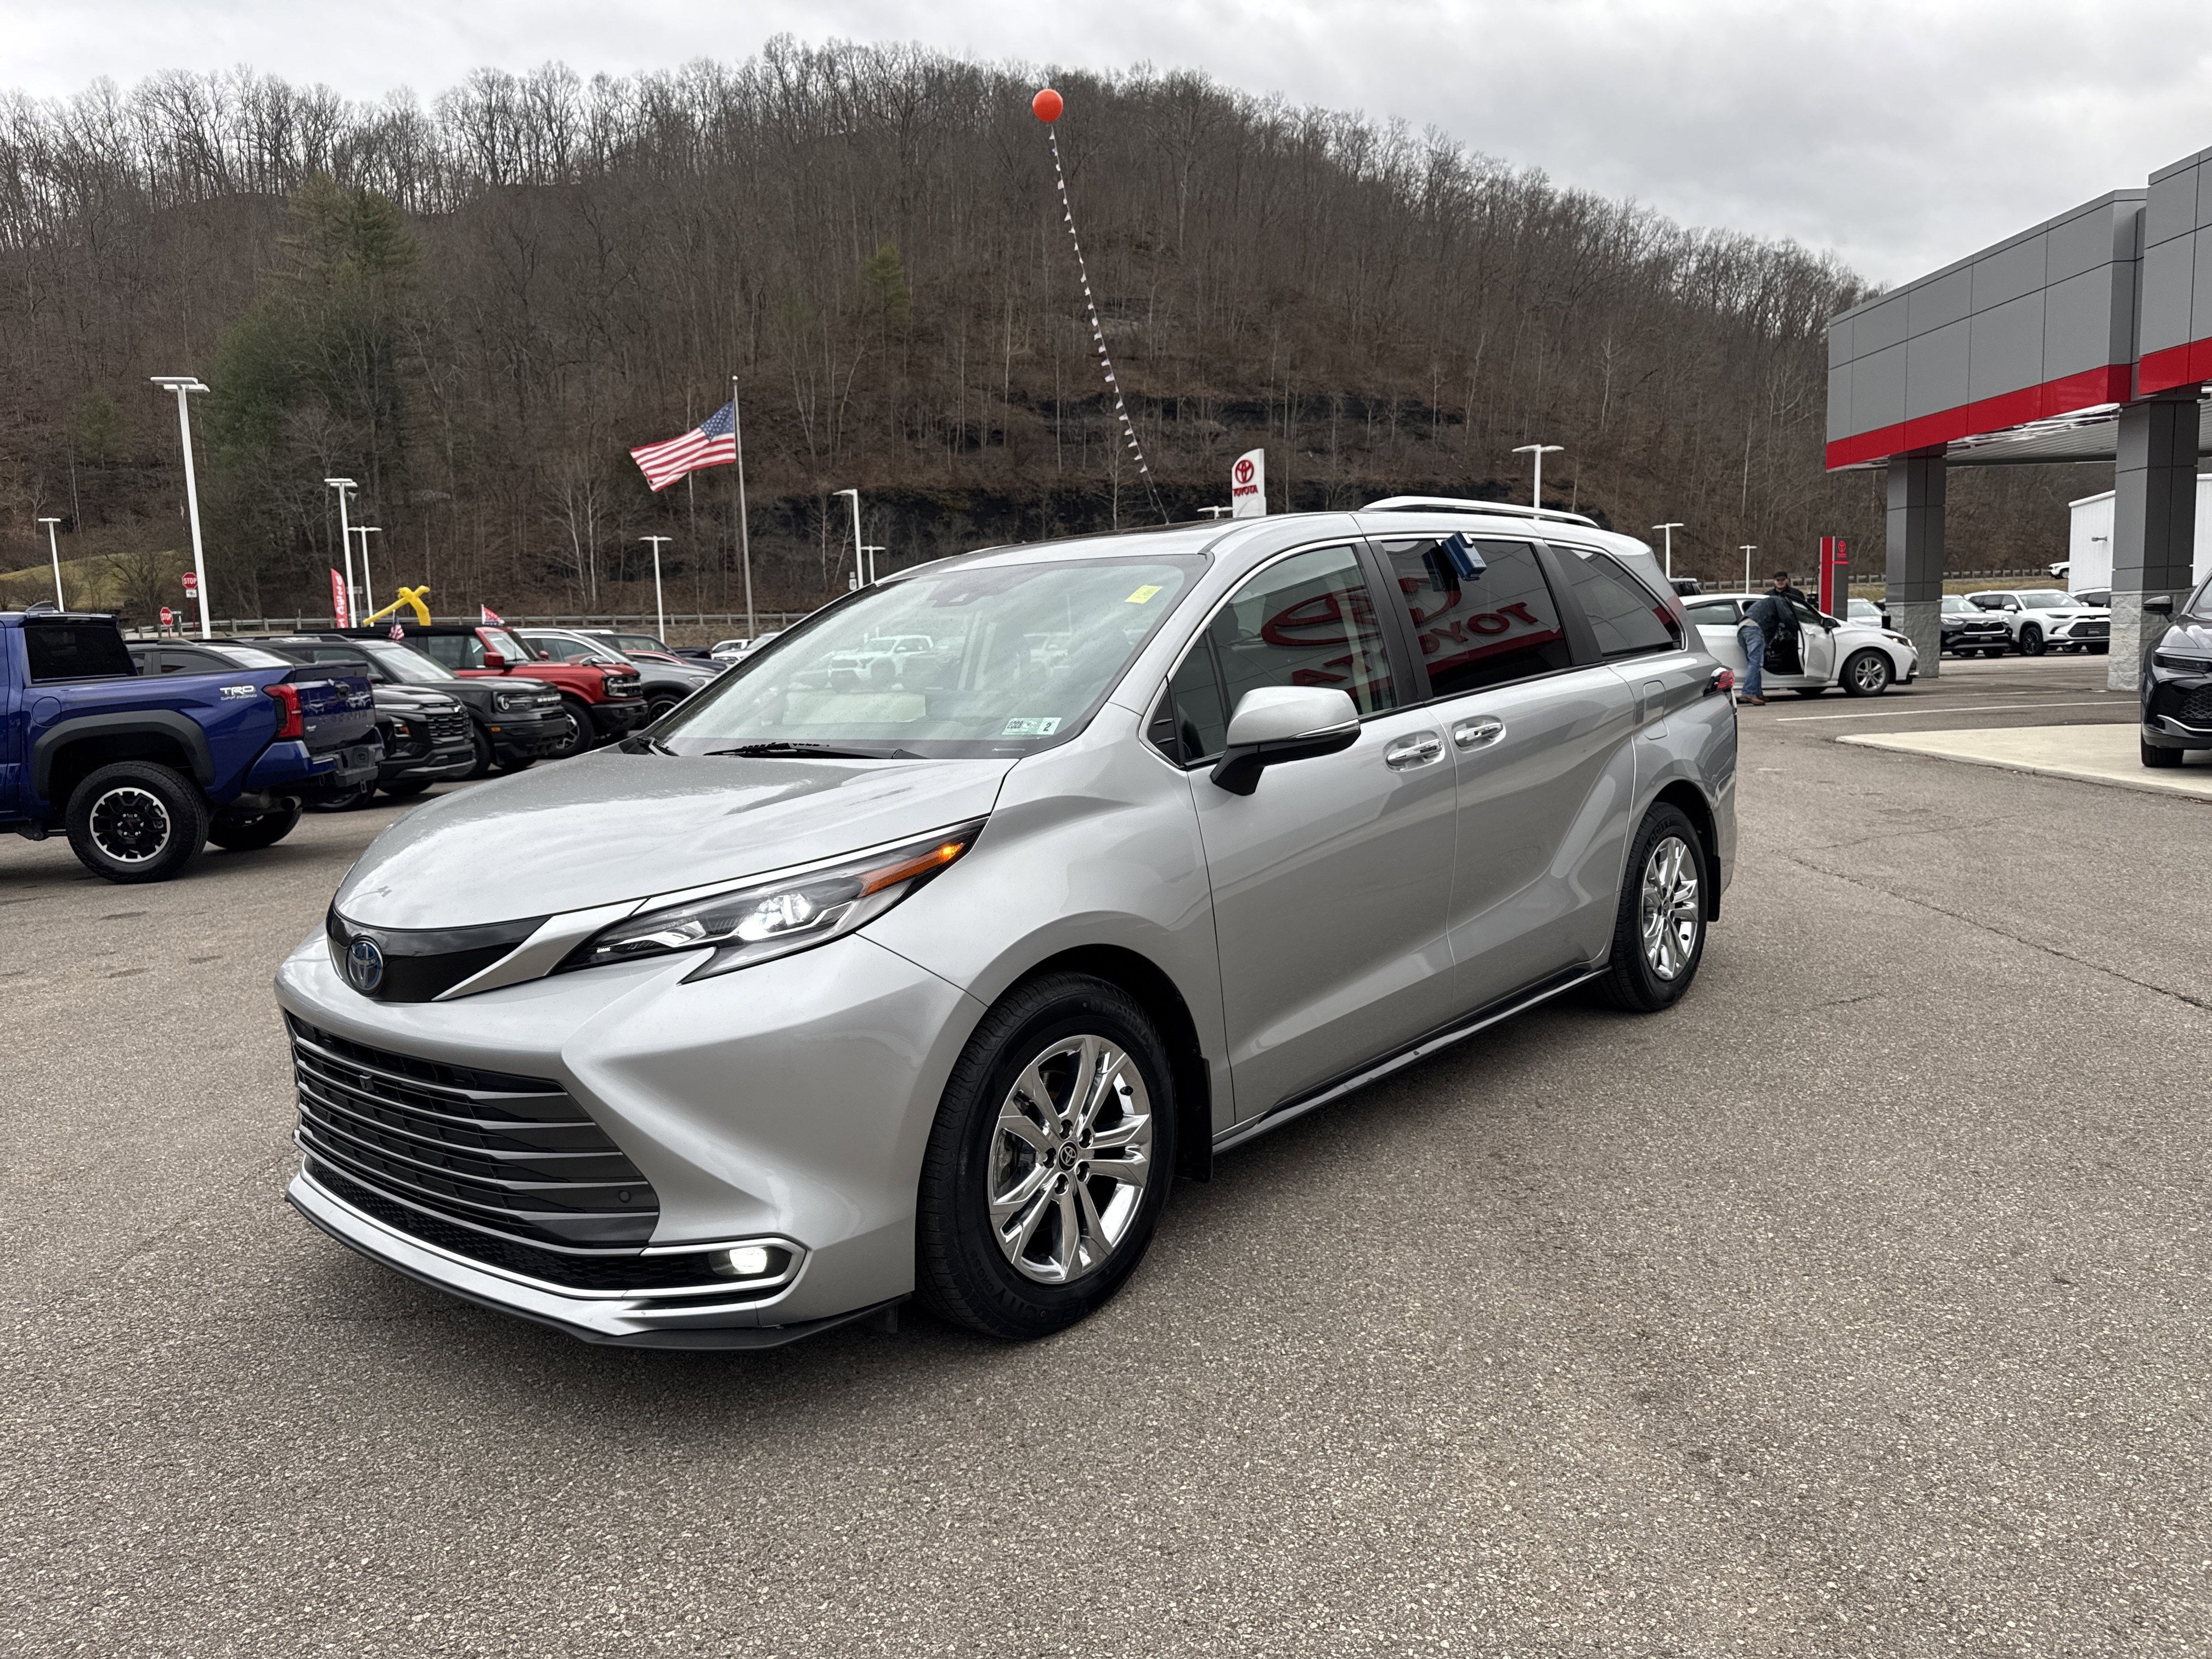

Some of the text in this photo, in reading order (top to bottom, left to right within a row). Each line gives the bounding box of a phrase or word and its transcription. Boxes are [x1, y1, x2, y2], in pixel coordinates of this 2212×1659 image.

[1233, 485, 1258, 497] TOYOTA
[219, 685, 256, 695] TRD
[1043, 722, 1052, 732] 2
